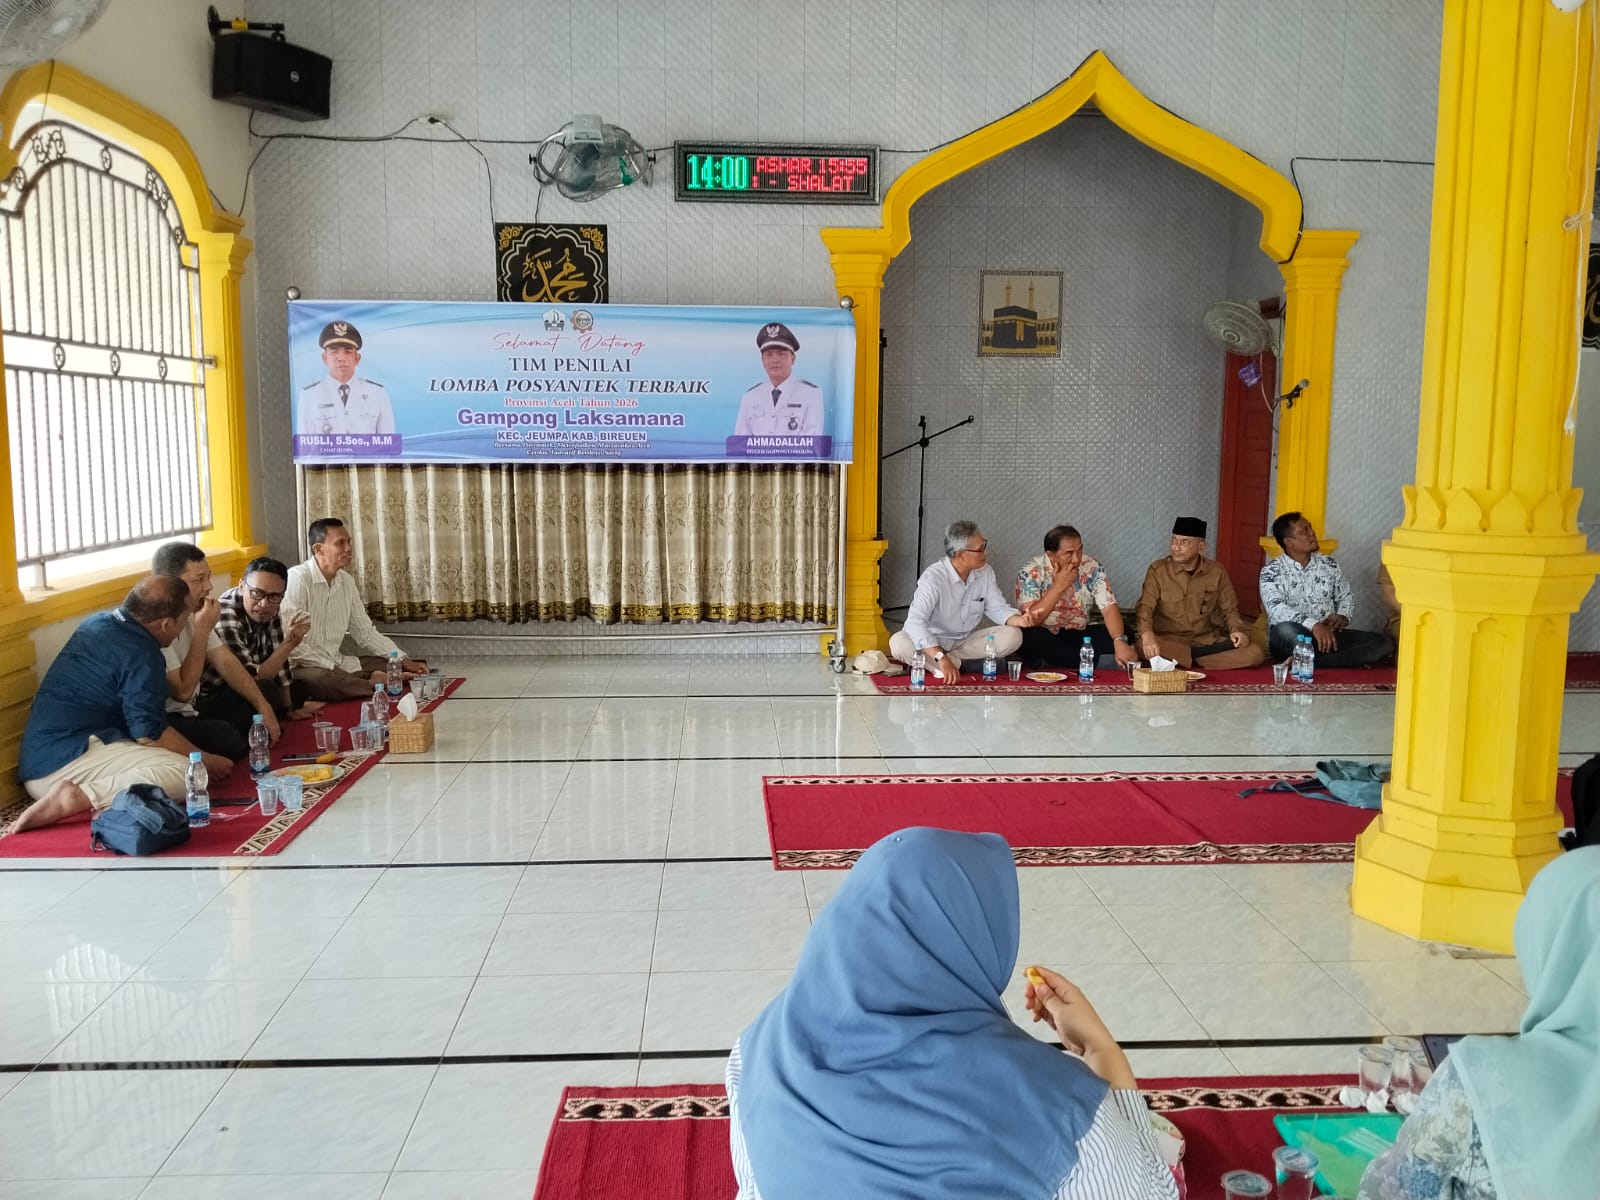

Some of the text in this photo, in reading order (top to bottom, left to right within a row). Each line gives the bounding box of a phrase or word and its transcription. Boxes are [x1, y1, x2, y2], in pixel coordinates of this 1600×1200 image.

[688, 155, 748, 190] 14:00
[756, 157, 812, 173] ASHAR
[788, 175, 854, 191] SHALAT
[492, 333, 646, 356] Selamat Datang
[508, 357, 632, 373] TIM PENILAI
[429, 378, 712, 394] LOMBA POSYANTEK TERBAIK
[504, 397, 638, 407] Provinsi Aceh Tahun 2026
[458, 409, 685, 428] Gampong Laksamana
[300, 436, 333, 447] RUSLI,
[372, 436, 393, 446] M.M
[497, 432, 646, 441] KEC. JEUMPA KAB. BIREUEN
[746, 437, 814, 447] AHMADALLAH
